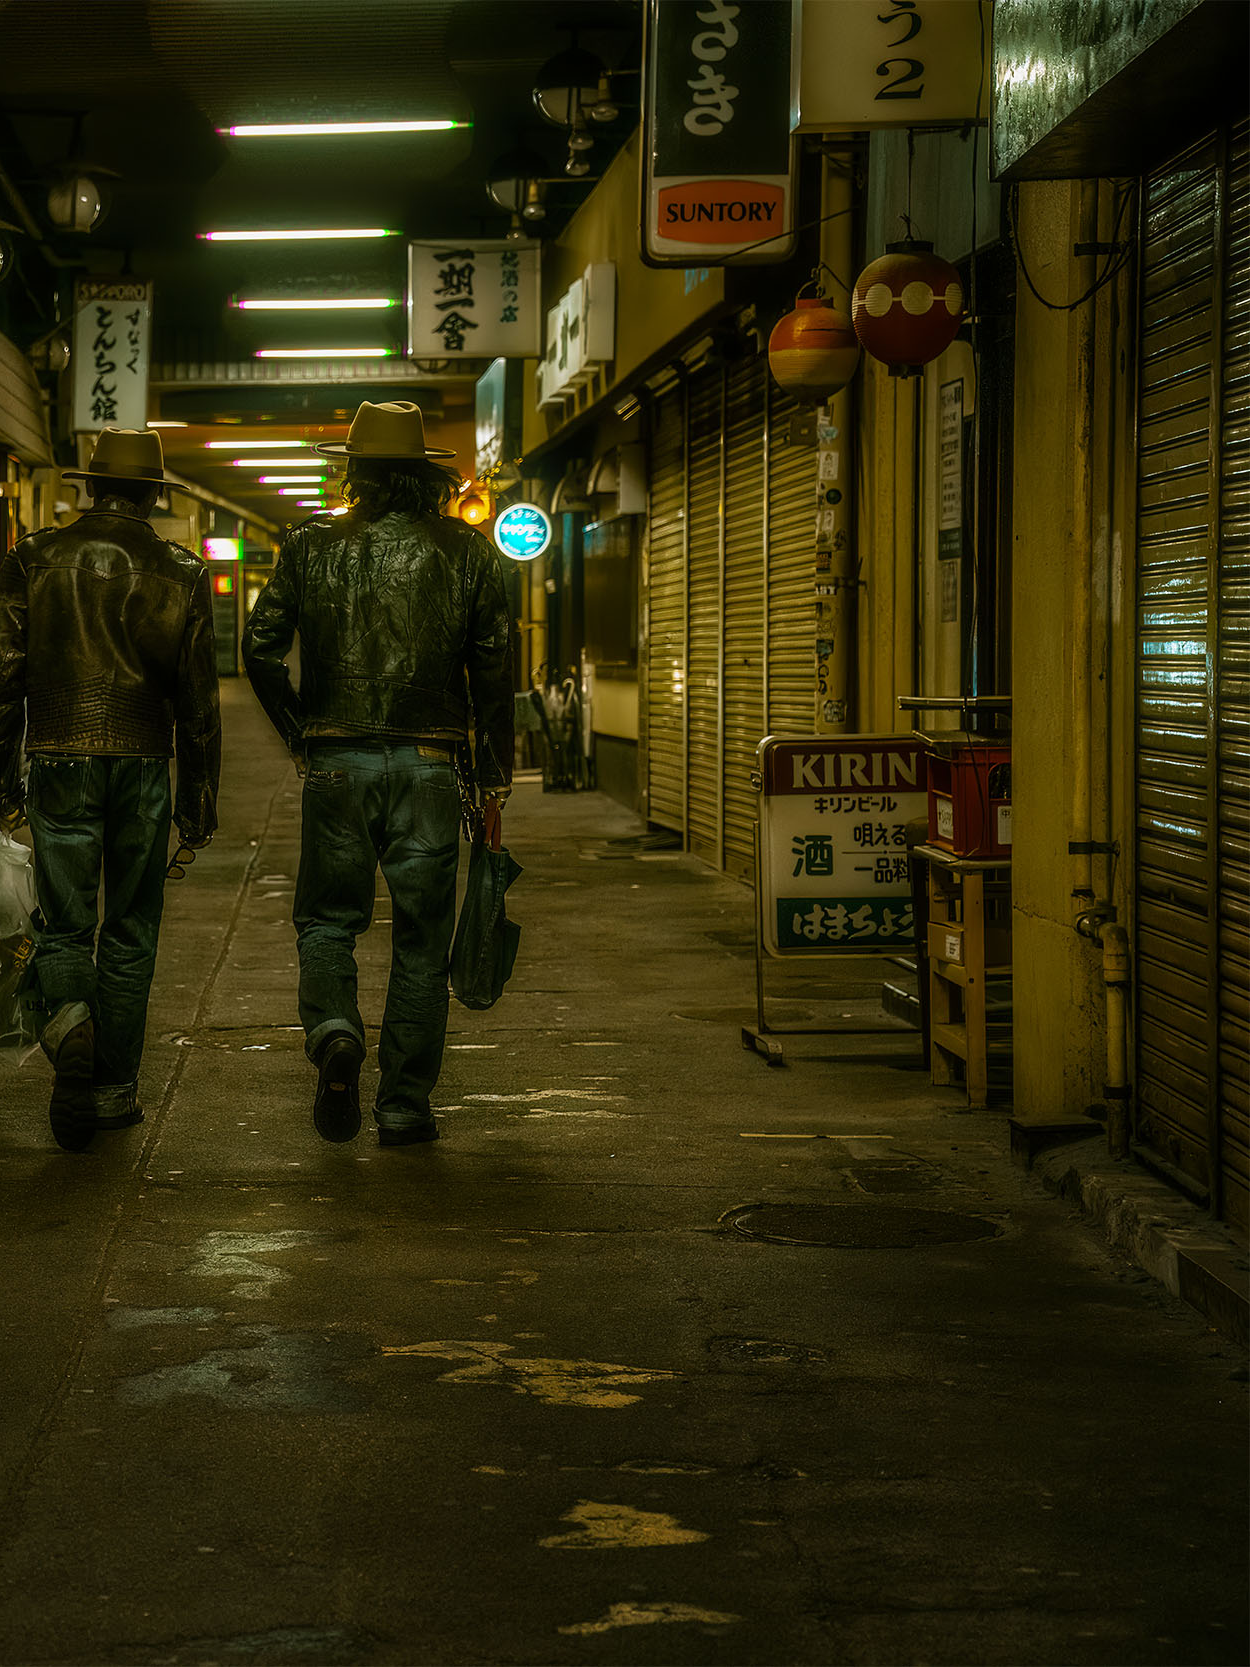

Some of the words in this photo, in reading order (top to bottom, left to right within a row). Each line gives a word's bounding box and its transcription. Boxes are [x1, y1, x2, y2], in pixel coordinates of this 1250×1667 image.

[666, 201, 777, 223] SUNTORY
[90, 306, 119, 422] とんちん館
[791, 752, 918, 790] KIRIN
[814, 797, 897, 814] キリンビール
[792, 835, 833, 877] 酒
